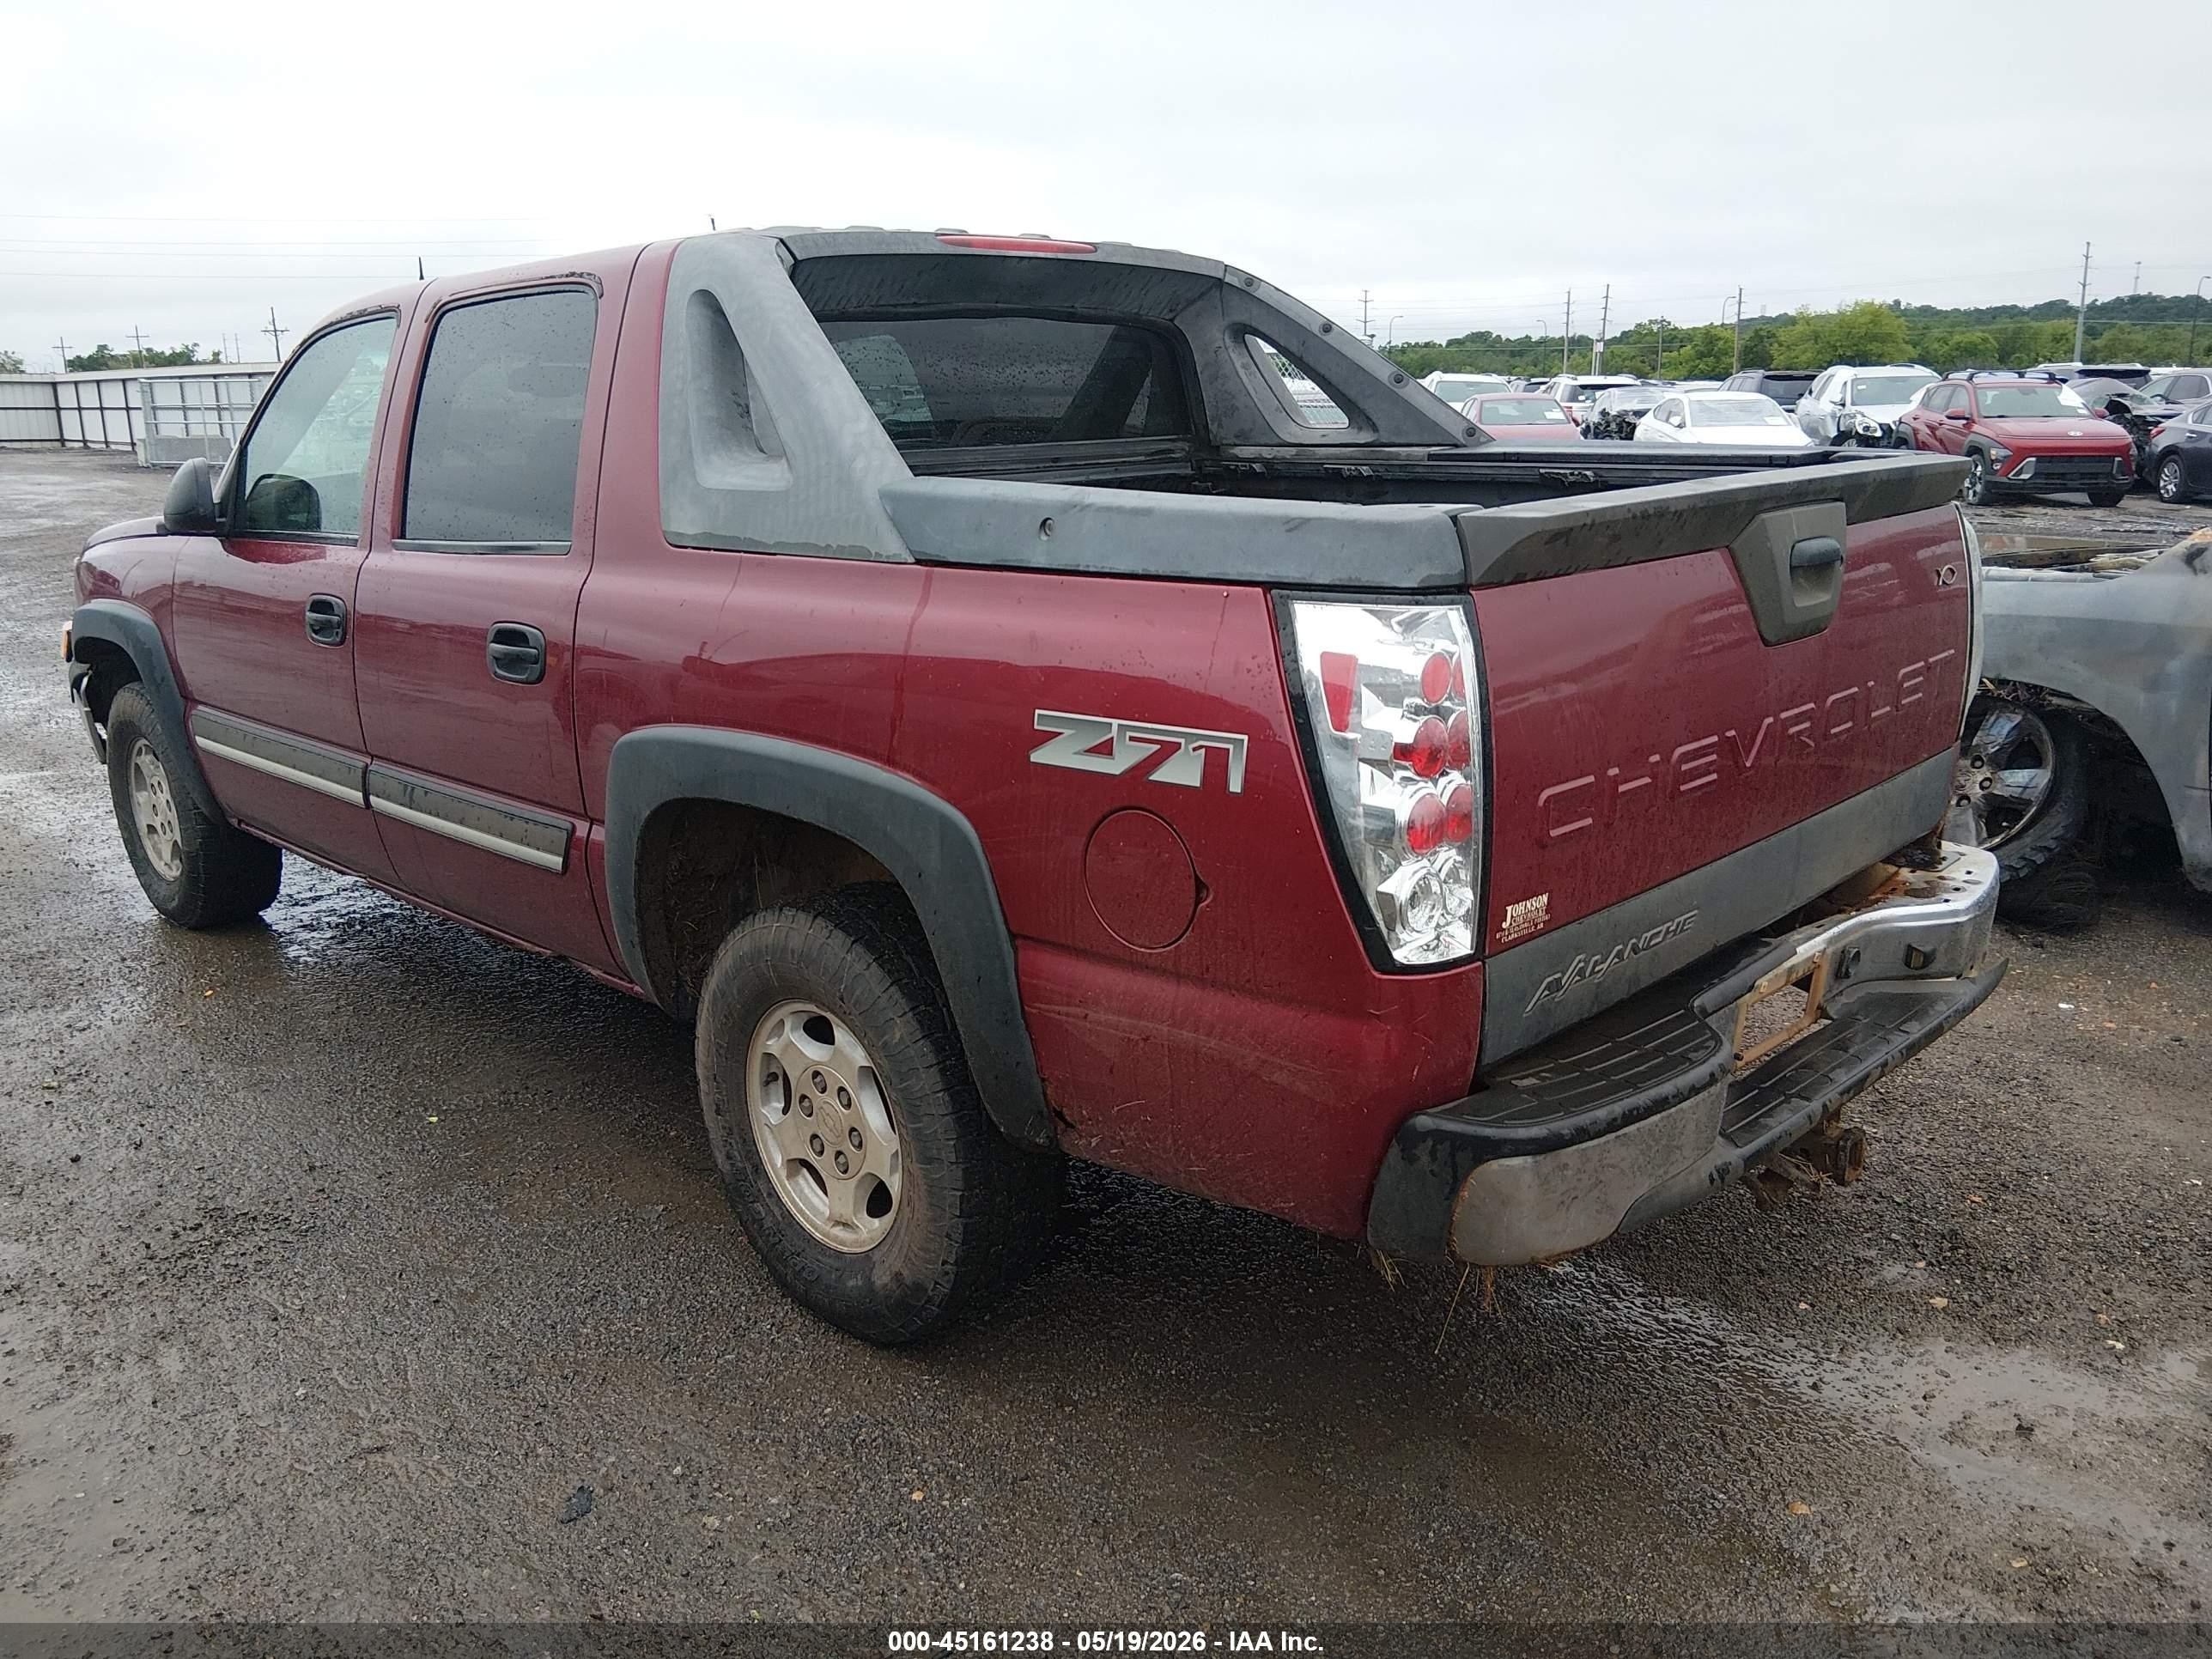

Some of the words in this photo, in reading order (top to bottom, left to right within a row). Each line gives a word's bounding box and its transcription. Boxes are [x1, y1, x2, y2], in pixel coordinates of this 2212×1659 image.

[1029, 707, 1249, 794] Z71
[1537, 648, 1956, 839] CHEVROLET
[1502, 893, 1548, 928] JOHNSON
[1511, 906, 1547, 926] CHEVROLET
[1523, 909, 1699, 1018] AVALANCHE
